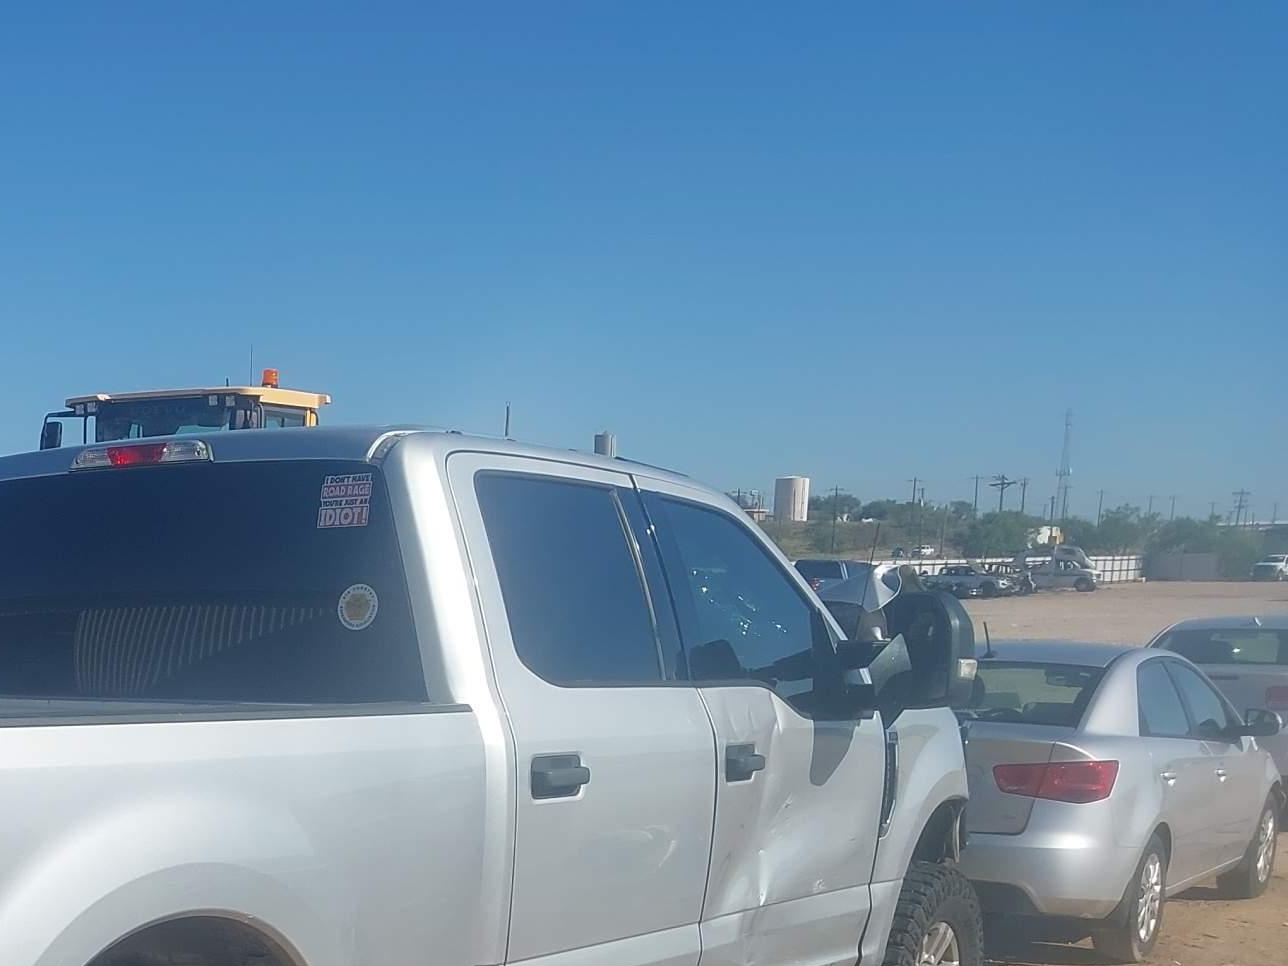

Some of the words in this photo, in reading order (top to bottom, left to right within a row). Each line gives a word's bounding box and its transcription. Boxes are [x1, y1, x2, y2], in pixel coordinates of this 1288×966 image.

[323, 486, 345, 498] ROAD
[347, 484, 370, 496] RAGE
[319, 507, 368, 527] IDIOT!
